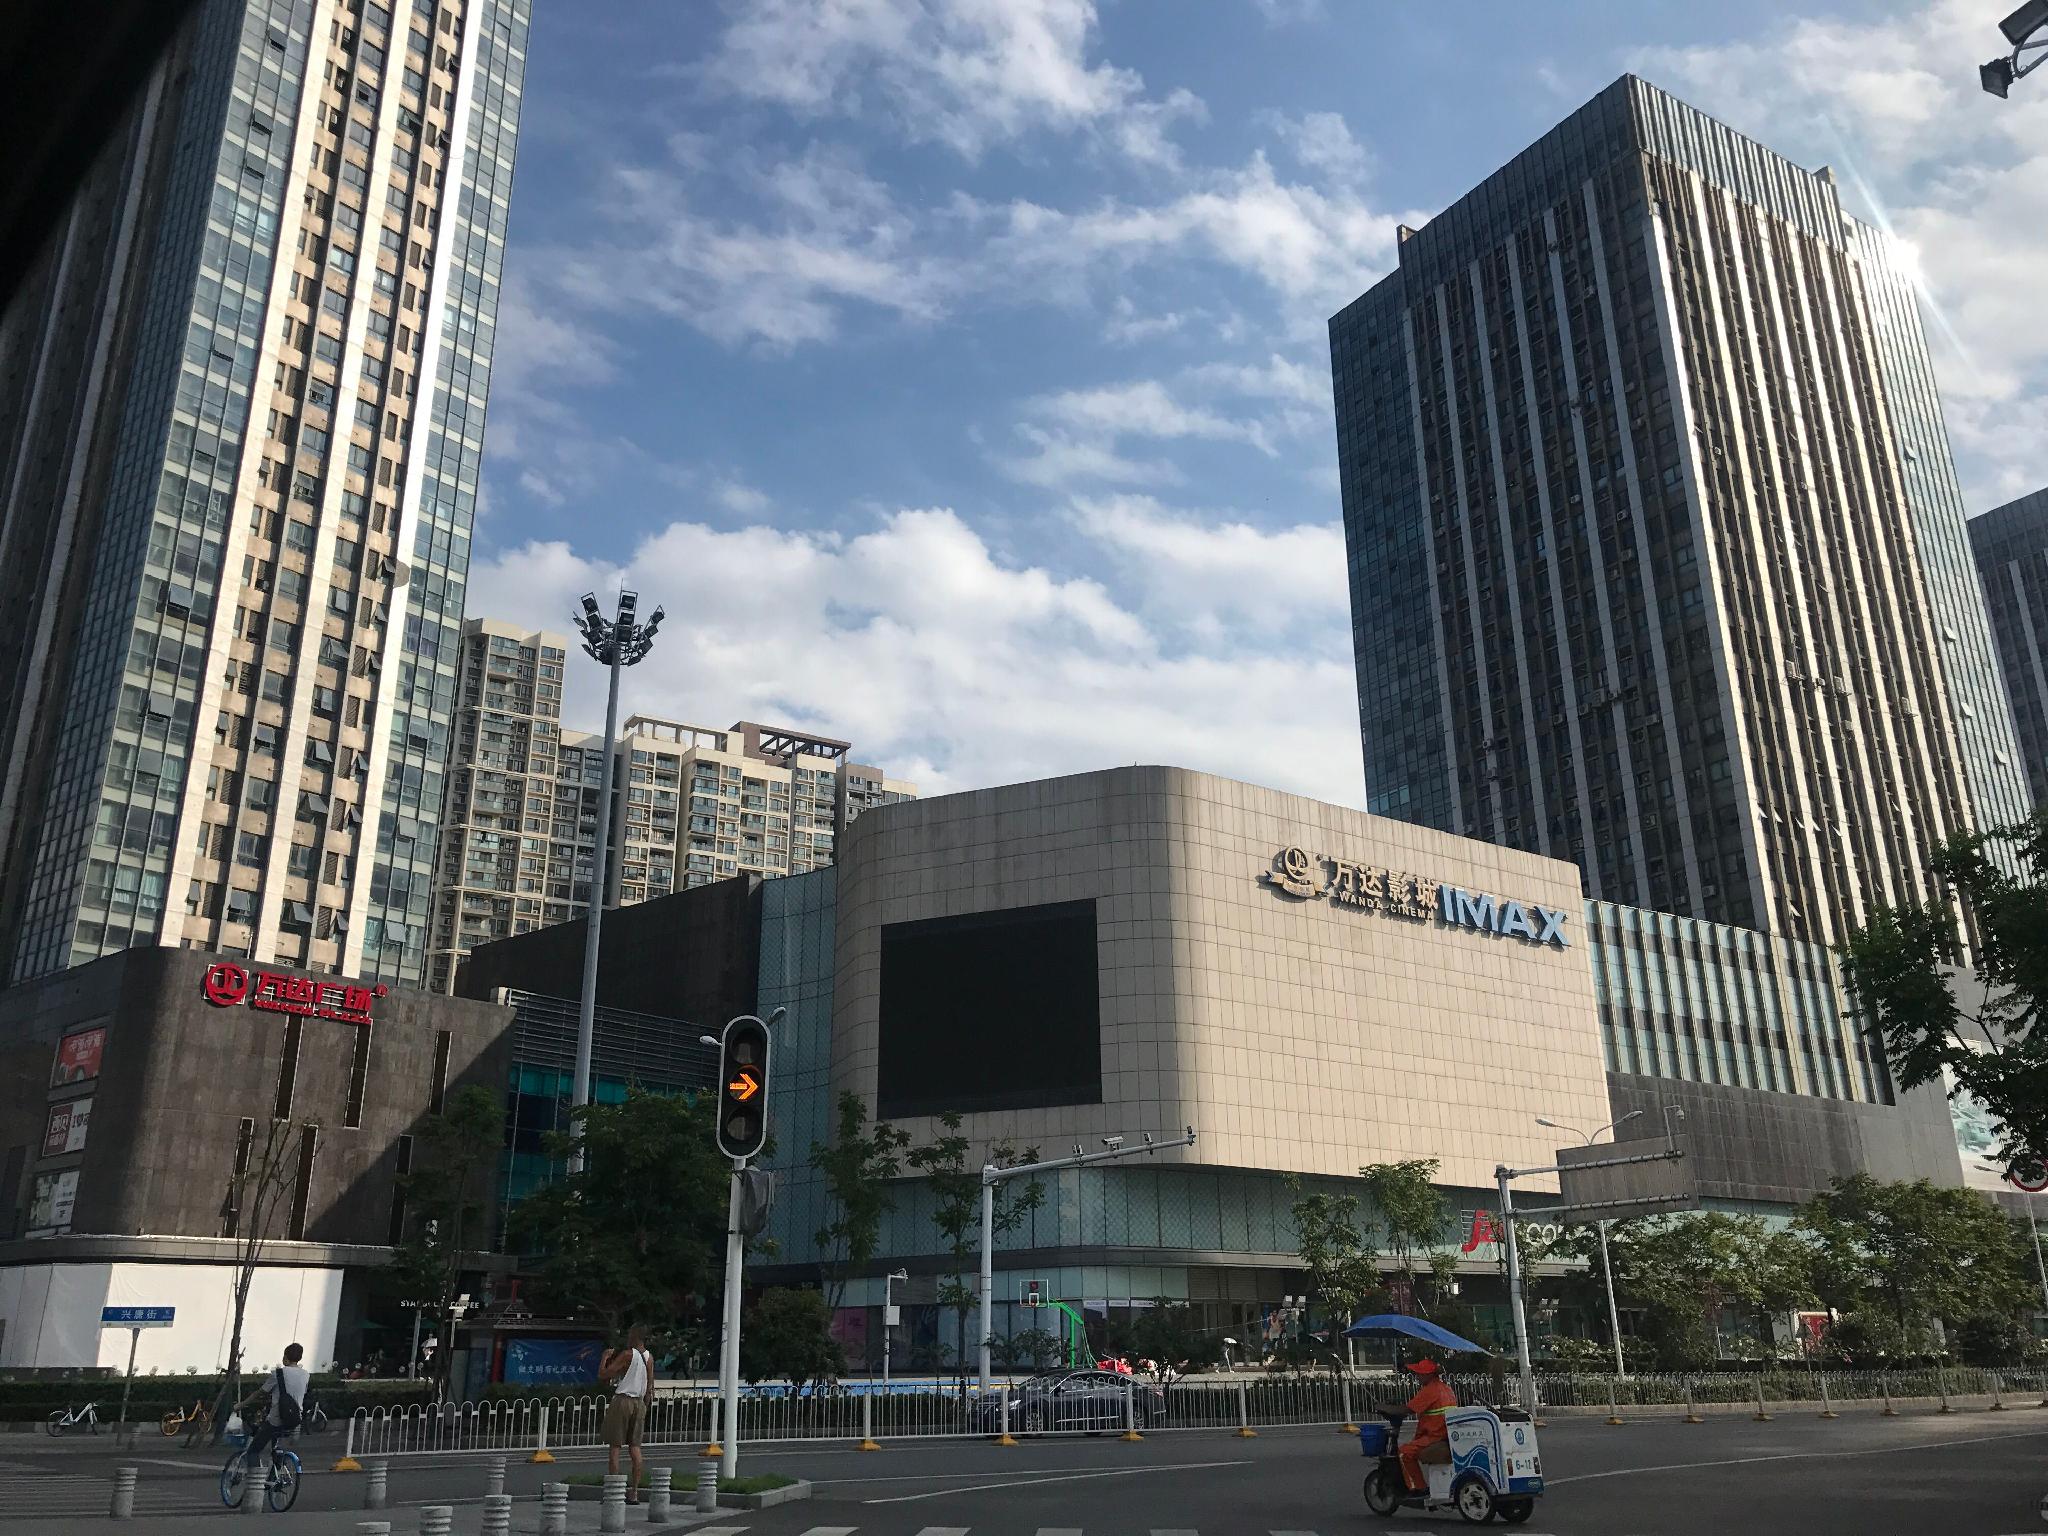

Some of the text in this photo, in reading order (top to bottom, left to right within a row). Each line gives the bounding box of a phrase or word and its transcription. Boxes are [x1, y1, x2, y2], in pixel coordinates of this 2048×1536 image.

[1332, 862, 1438, 910] 万达影城
[1339, 891, 1434, 921] WANDA CINEMA
[1441, 884, 1569, 946] IMAX
[256, 971, 372, 1012] 万达广场
